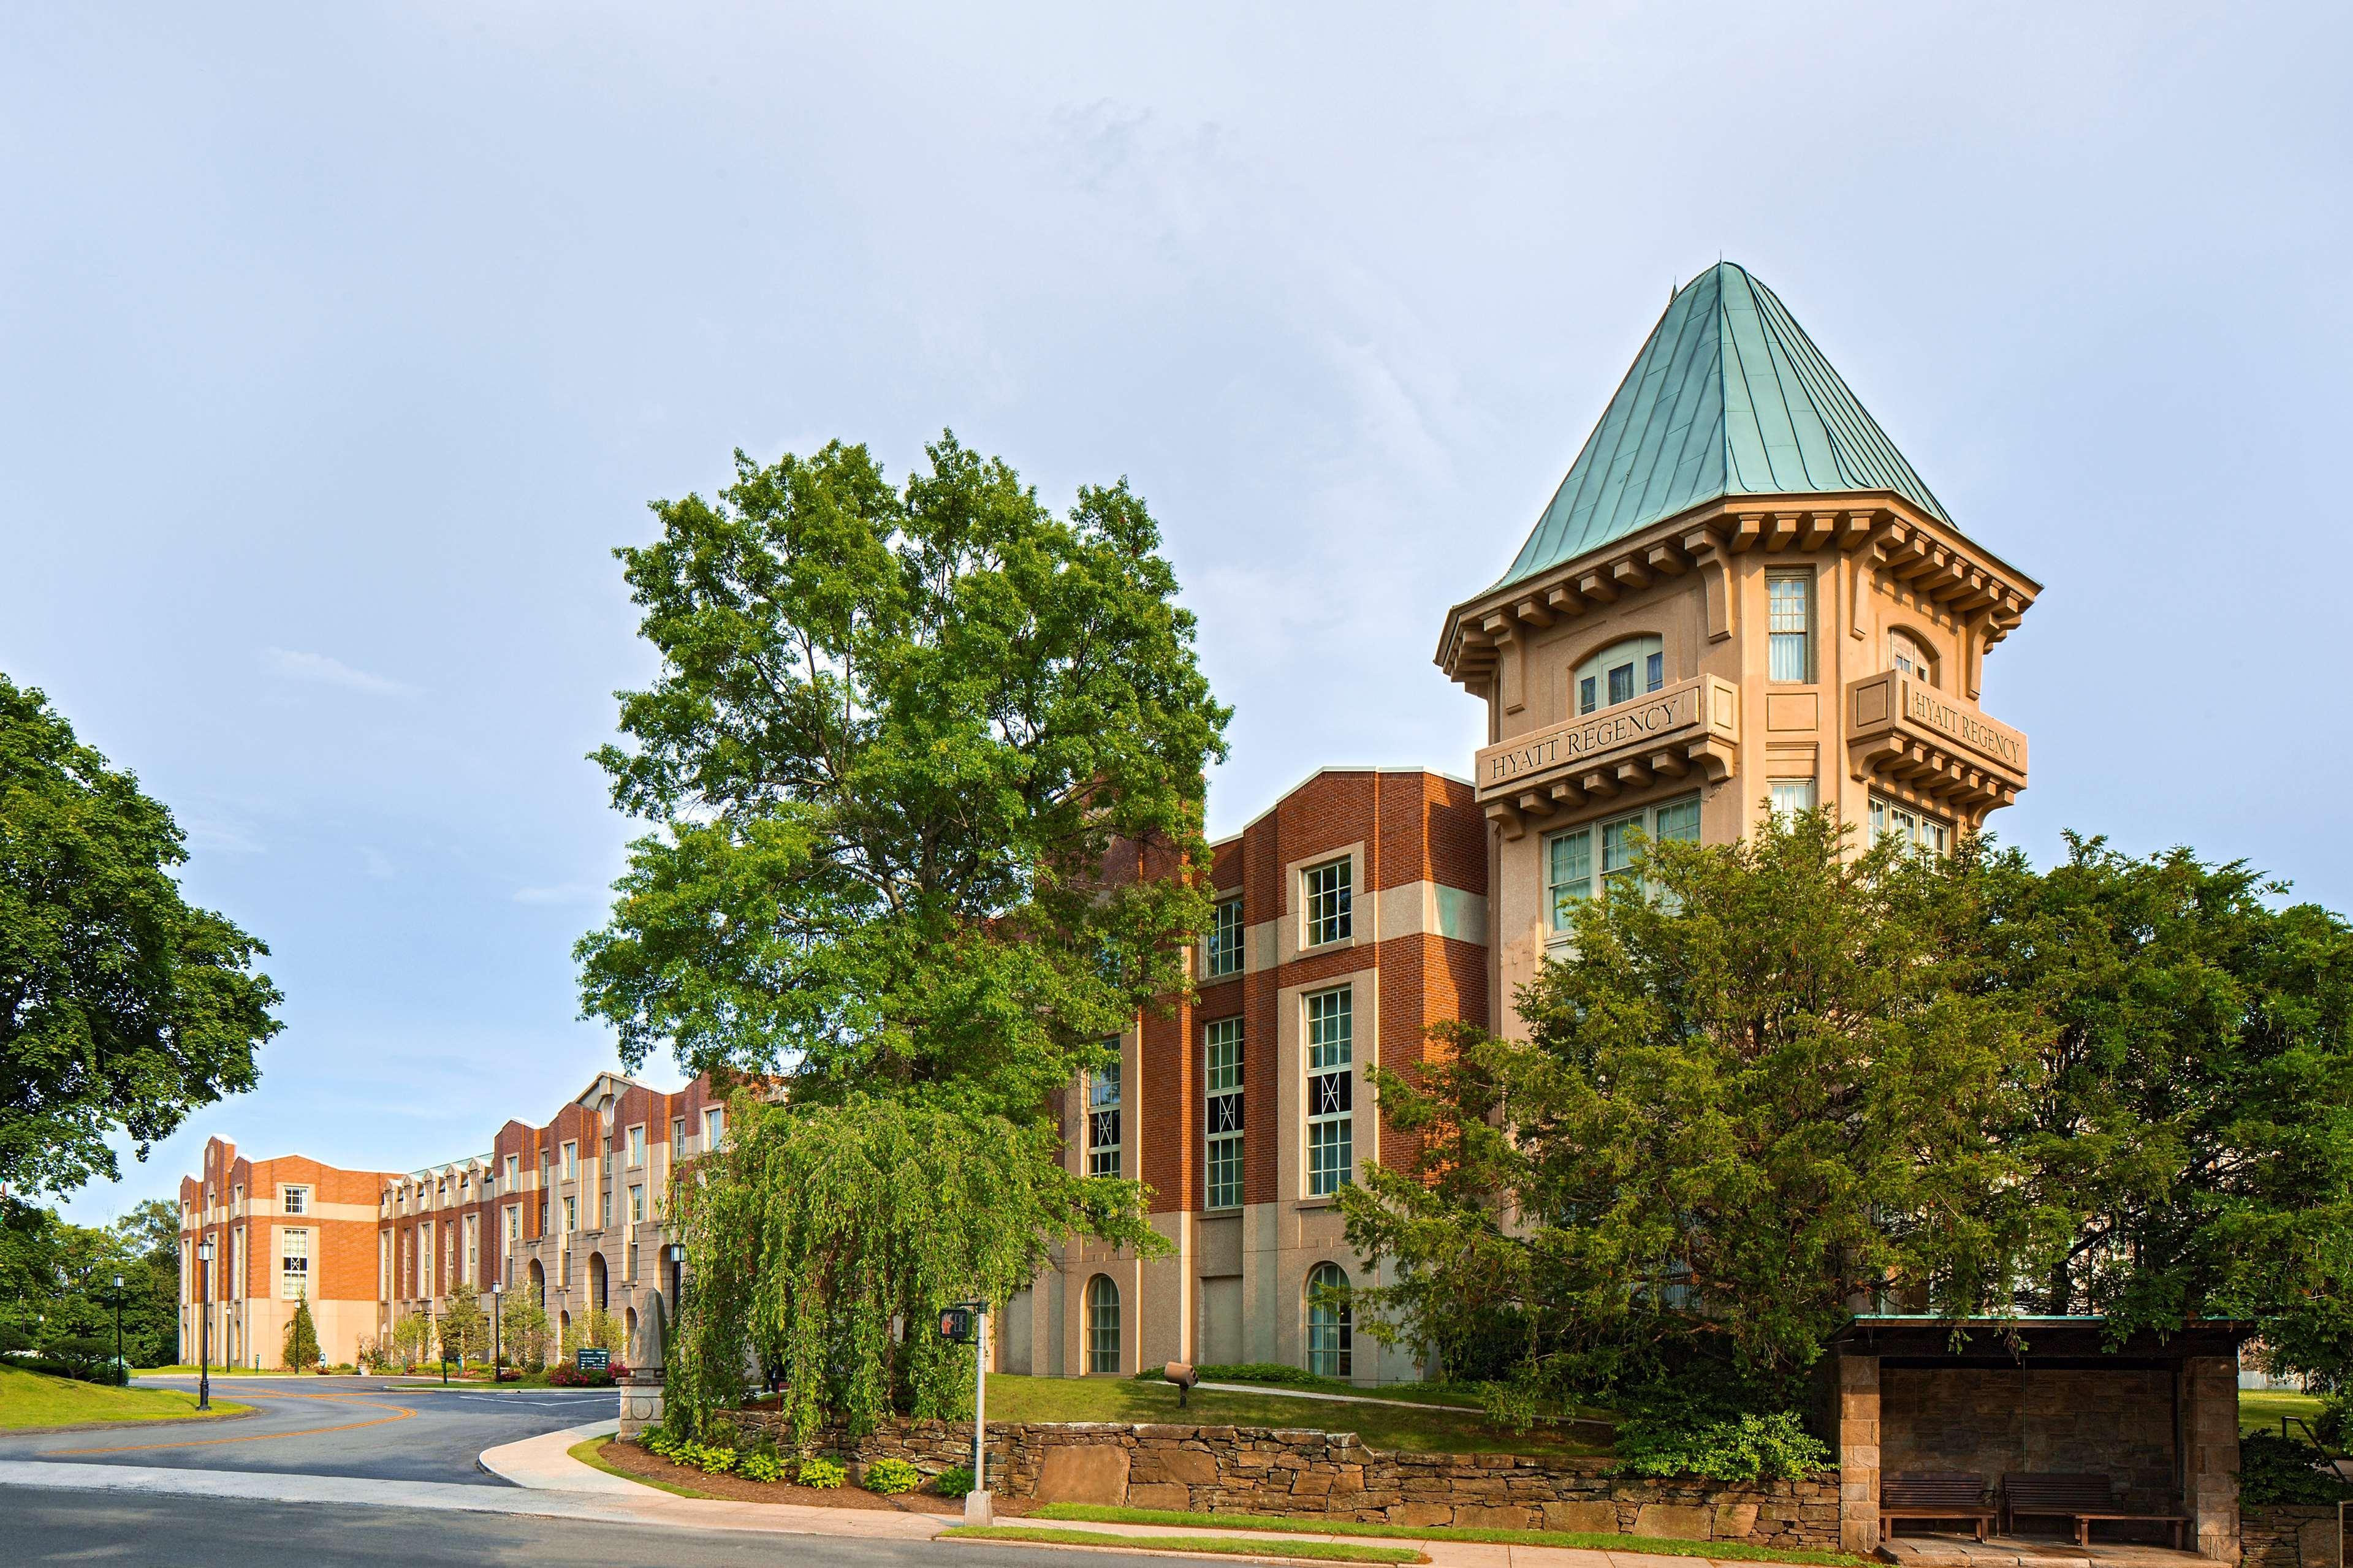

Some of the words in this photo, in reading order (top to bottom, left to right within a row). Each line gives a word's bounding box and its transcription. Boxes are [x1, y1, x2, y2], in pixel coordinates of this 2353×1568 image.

[1491, 738, 1559, 779] HYATT
[1567, 700, 1678, 756] REGENCY
[1916, 692, 1958, 733] HYATT
[1962, 715, 2020, 764] REGENCY
